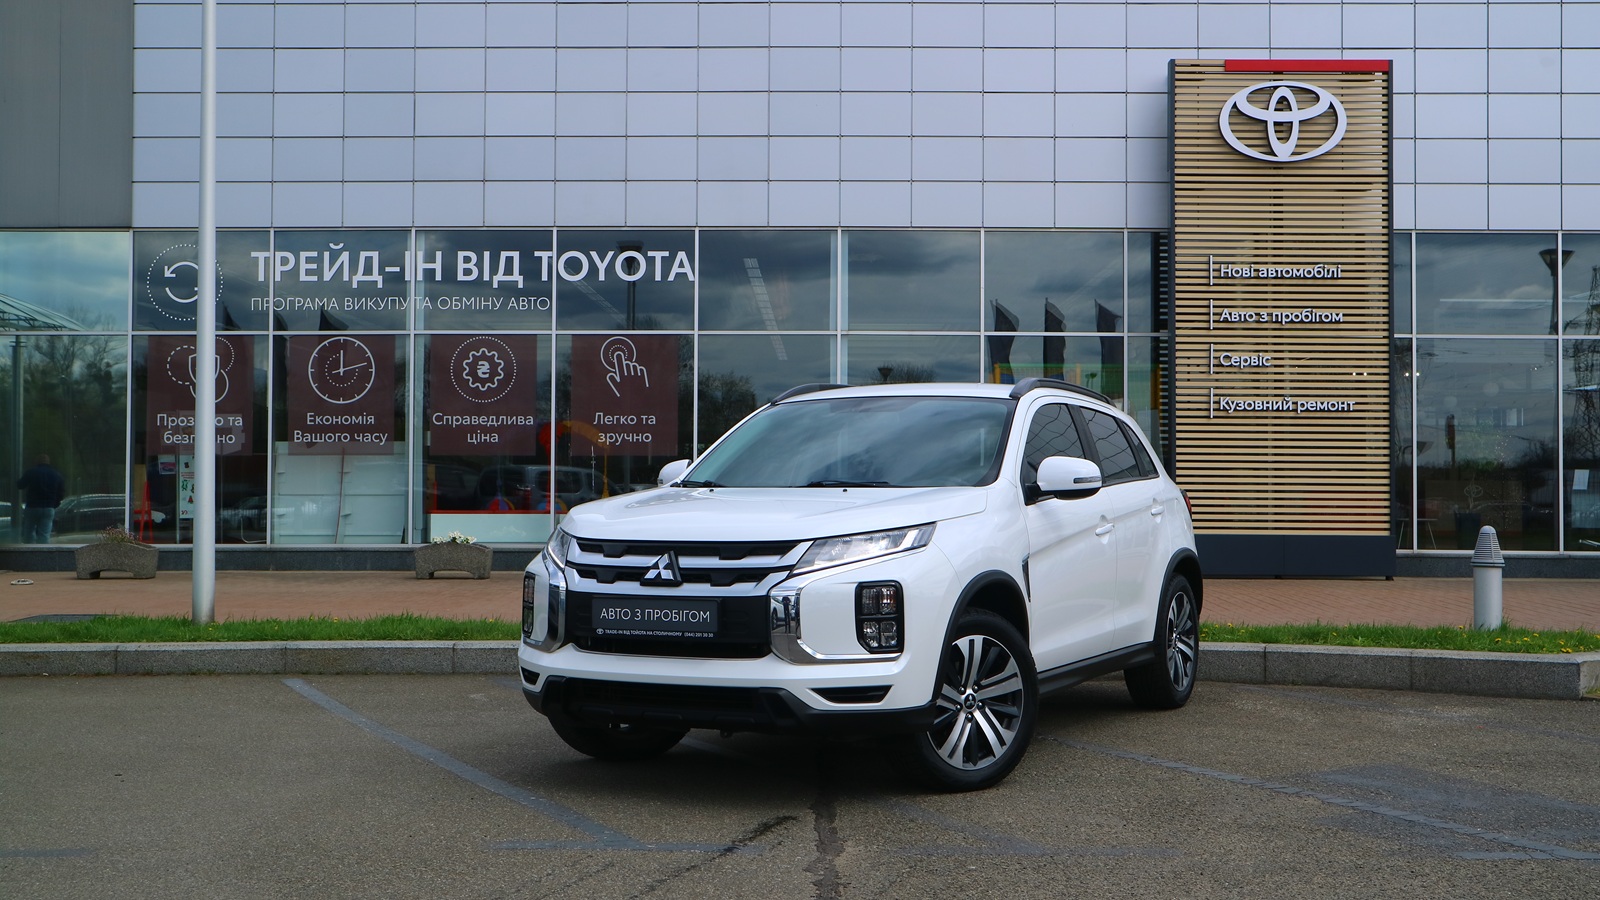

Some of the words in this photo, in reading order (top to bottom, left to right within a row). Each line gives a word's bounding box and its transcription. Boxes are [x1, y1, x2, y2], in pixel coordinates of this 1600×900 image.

[251, 243, 442, 288] ТРЕЙД-ІН
[457, 250, 524, 288] ВІД
[534, 250, 696, 282] TOYOTA
[1220, 264, 1254, 278] Нові
[1258, 264, 1342, 278] автомобілі
[251, 297, 339, 311] ПРОГРАМА
[344, 297, 410, 311] ВИКУПУ
[414, 296, 432, 310] ТА
[437, 296, 504, 310] ОБМІНУ
[507, 296, 550, 310] АВТО
[1220, 309, 1255, 322] Авто
[1259, 311, 1268, 322] з
[1272, 308, 1343, 326] пробігом
[1219, 353, 1272, 369] Сервіс
[1219, 397, 1293, 414] Кузовний
[1297, 399, 1356, 414] ремонт
[157, 413, 224, 429] Прозо
[228, 416, 243, 426] та
[306, 412, 375, 425] Економія
[432, 412, 534, 427] Справедлива
[593, 412, 637, 425] Легко
[640, 415, 656, 425] та
[294, 430, 350, 444] Вашого
[355, 432, 388, 446] часу
[467, 431, 499, 445] ціна
[598, 431, 652, 446] зручно
[600, 608, 631, 620] АВТО
[645, 609, 710, 622] ПРОБІГОМ
